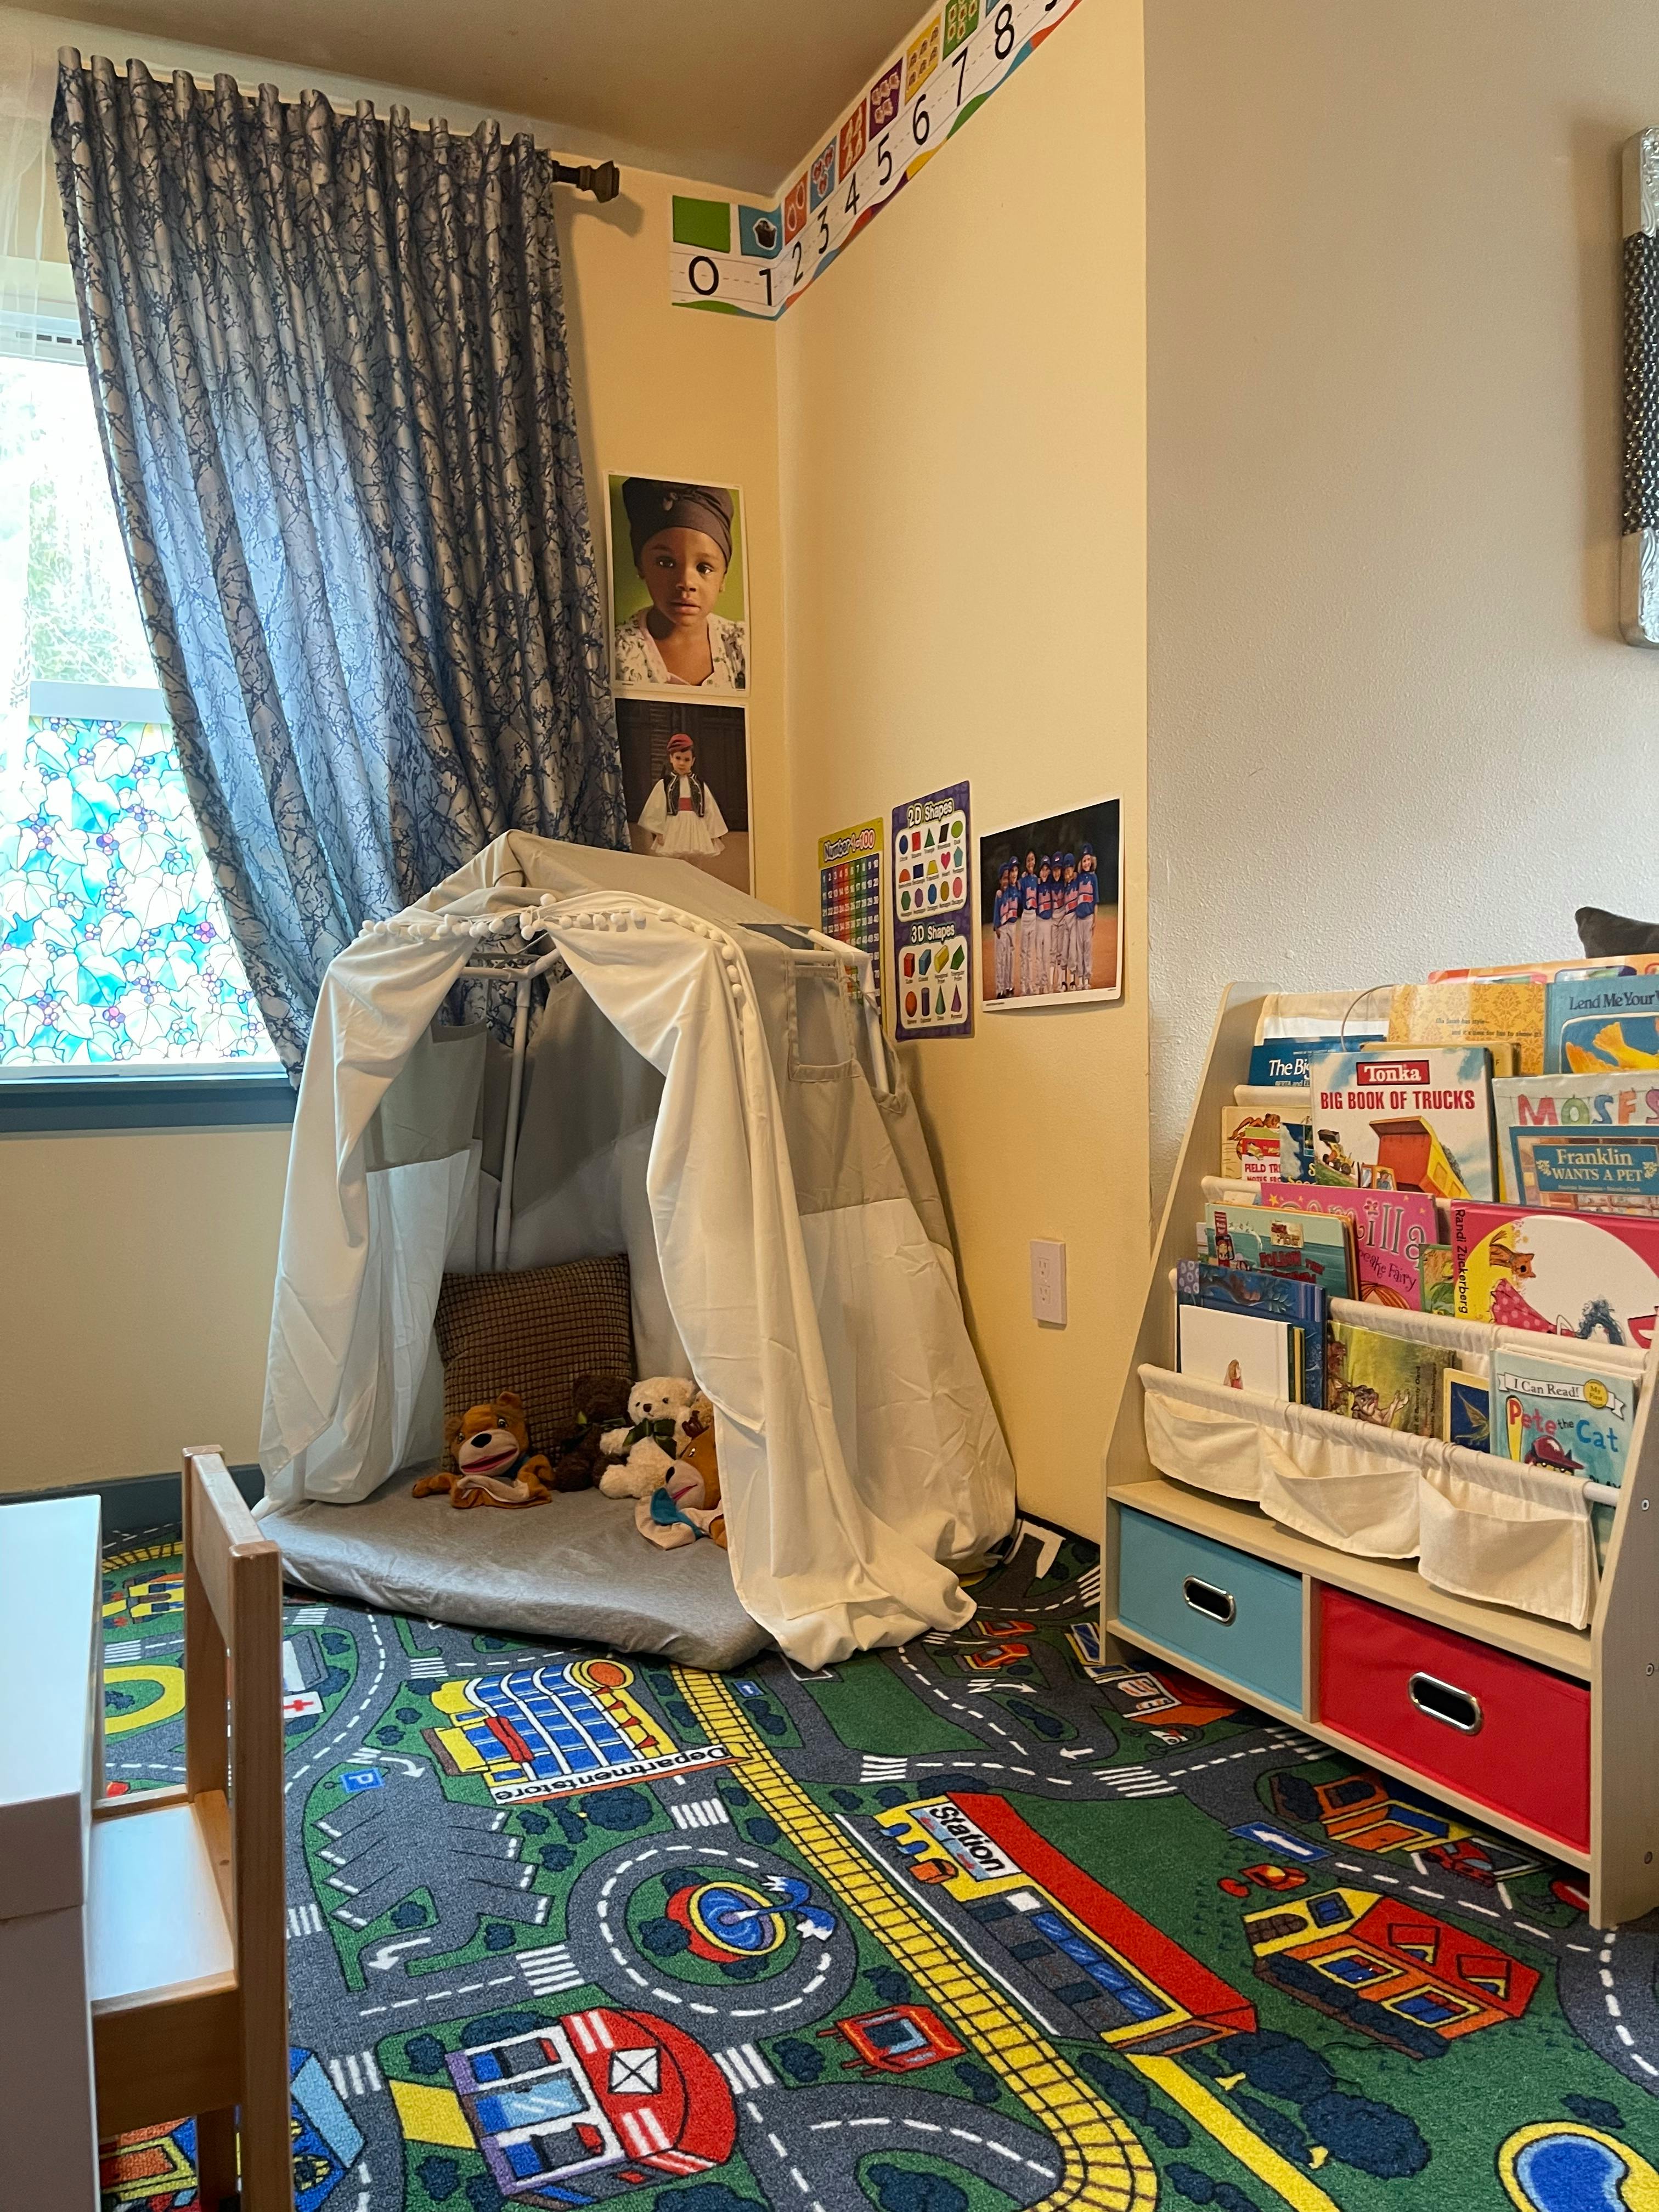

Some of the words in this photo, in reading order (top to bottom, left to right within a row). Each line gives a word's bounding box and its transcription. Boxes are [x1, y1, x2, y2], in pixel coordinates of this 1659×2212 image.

[689, 255, 719, 295] 0
[759, 268, 774, 306] 1
[792, 242, 803, 286] 2
[817, 206, 829, 254] 3
[845, 172, 860, 215] 4
[877, 133, 893, 185] 5
[912, 94, 930, 146] 6
[951, 47, 968, 107] 7
[994, 3, 1015, 59] 8
[908, 805, 922, 828] 2D
[924, 800, 953, 821] Shapes
[911, 924, 924, 943] 3D
[928, 924, 955, 944] Shapes
[1569, 994, 1600, 1010] Lend
[1602, 994, 1623, 1008] Me
[1623, 992, 1655, 1006] Your
[1269, 1059, 1293, 1076] The
[1364, 1064, 1421, 1082] Tonka
[1321, 1092, 1343, 1109] BIG
[1348, 1091, 1385, 1109] BOOK
[1390, 1091, 1407, 1109] OF
[1413, 1090, 1475, 1109] TRUCKS
[1556, 1148, 1633, 1166] Franklin
[1245, 1164, 1266, 1173] FIELD
[1551, 1168, 1600, 1180] WANTS
[1603, 1169, 1614, 1181] A
[1617, 1169, 1643, 1182] PET
[1455, 1209, 1466, 1242] Randi
[1389, 1263, 1417, 1291] Fairy
[1457, 1246, 1469, 1313] Zuckerberg
[1514, 1379, 1518, 1389] I
[1521, 1381, 1544, 1394] Can
[1547, 1384, 1579, 1397] Read!
[1590, 1386, 1600, 1395] My
[1509, 1399, 1557, 1435] Pete
[1558, 1418, 1574, 1429] the
[1576, 1420, 1618, 1452] Cat
[357, 1775, 373, 1786] P
[495, 1747, 730, 1801] Departmentstore
[931, 1806, 1006, 1873] Station
